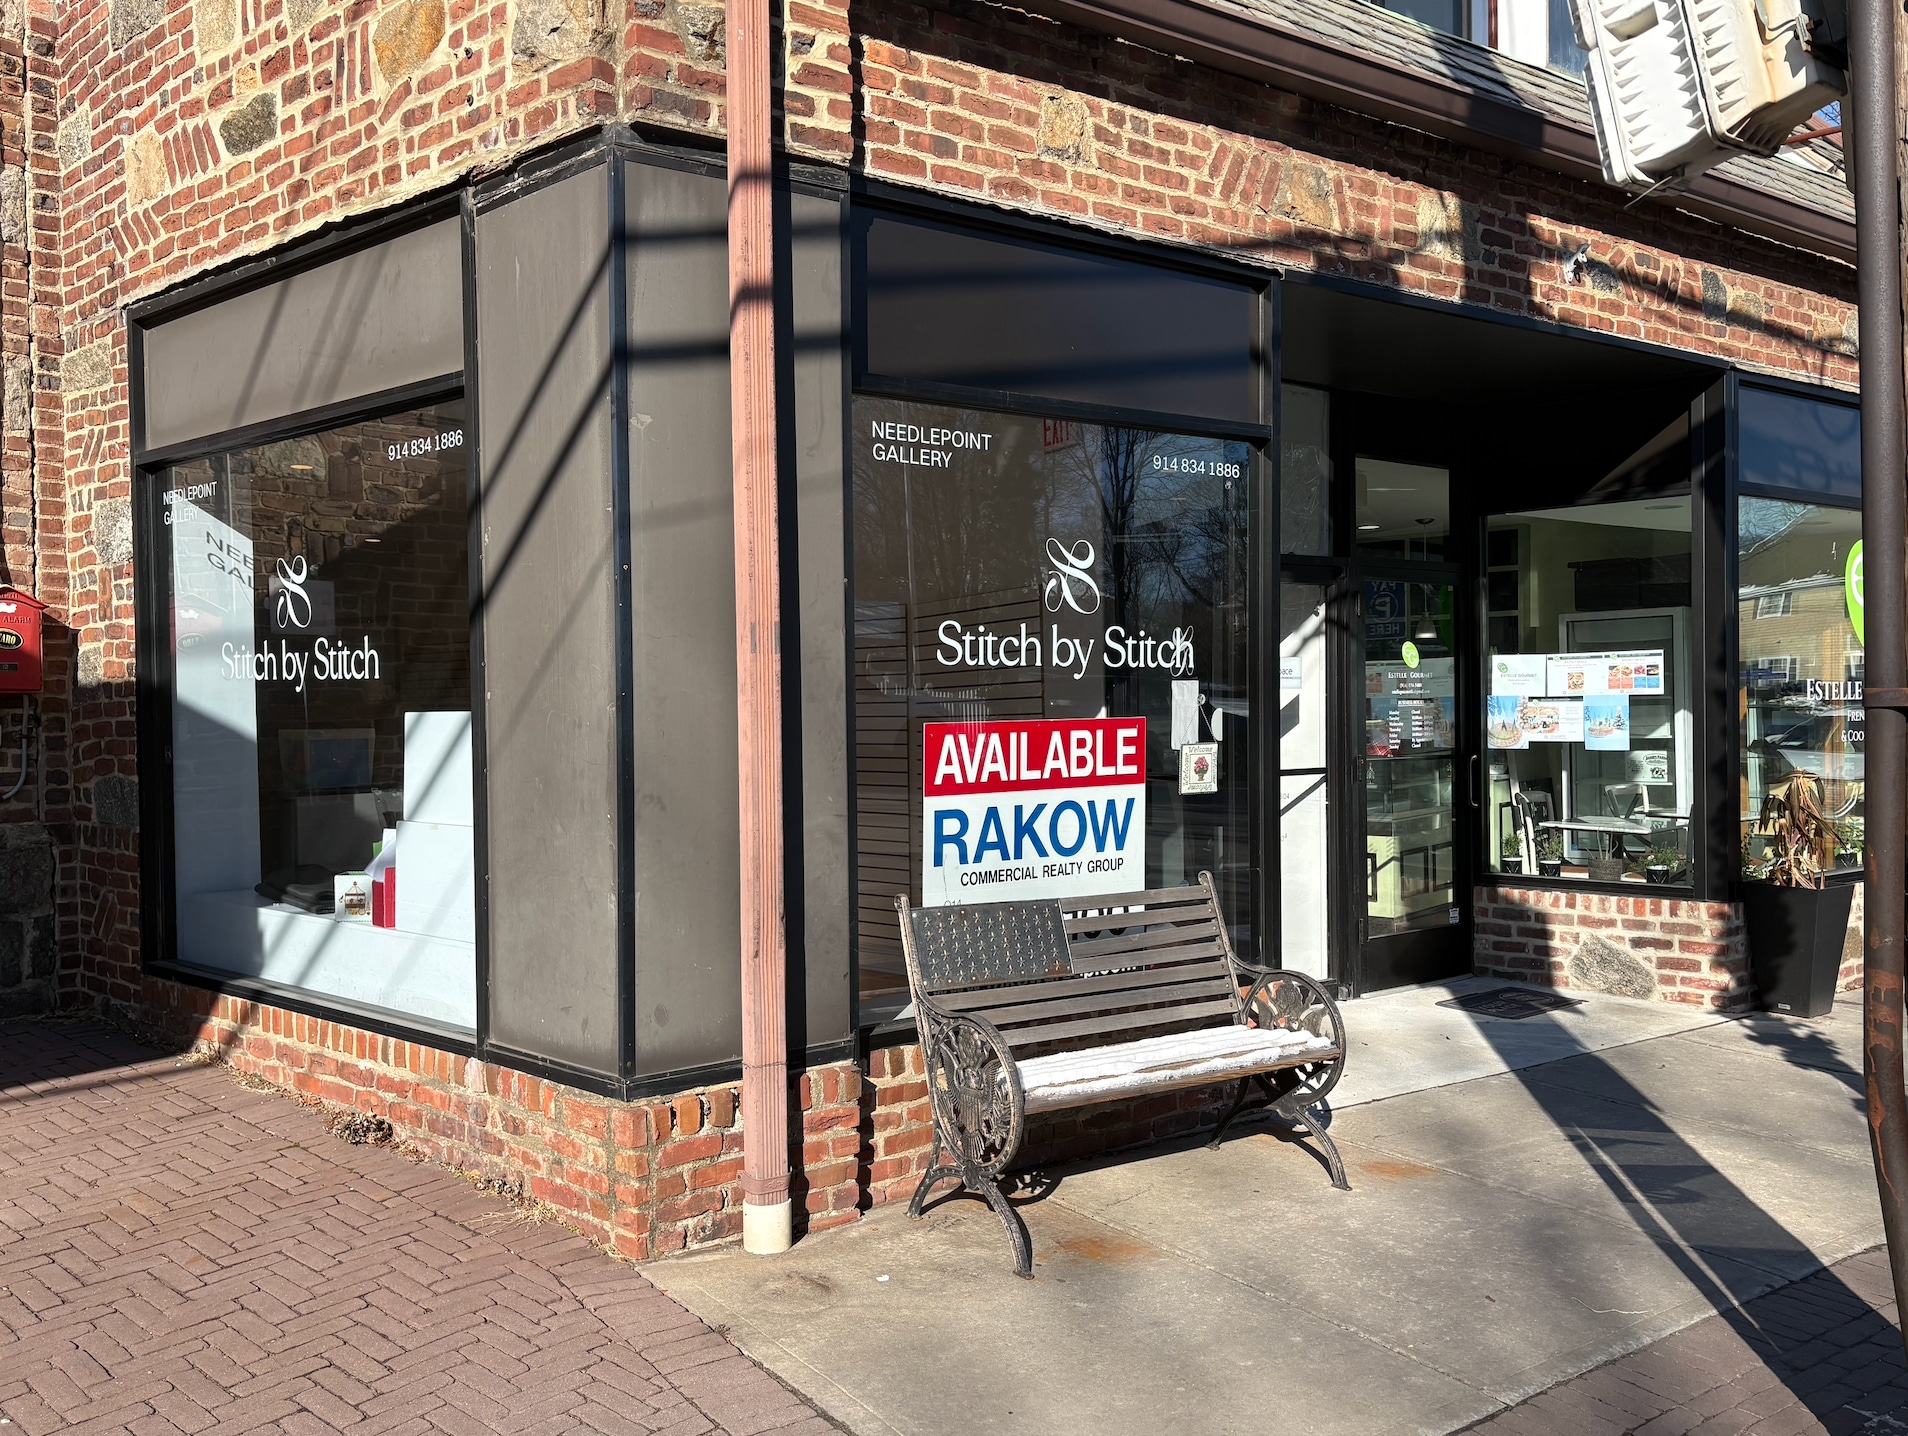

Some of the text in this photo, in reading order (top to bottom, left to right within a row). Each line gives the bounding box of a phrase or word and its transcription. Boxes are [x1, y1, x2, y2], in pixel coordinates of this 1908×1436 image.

[388, 429, 463, 461] 914 834 1886
[872, 421, 992, 450] NEEDLEPOINT
[872, 443, 953, 468] GALLERY
[1153, 455, 1240, 478] 914 834 1886
[163, 481, 217, 505] NEEDLEPOINT
[163, 506, 199, 525] GALLERY
[221, 641, 277, 681] Stitch
[281, 638, 308, 693] by
[313, 634, 380, 681] Stitch
[936, 620, 1195, 680] Stitch by Stitch
[1806, 678, 1863, 701] ESTELLE
[1841, 729, 1847, 742] &
[933, 727, 1139, 786] AVAILABLE
[933, 797, 1136, 868] RAKOW
[960, 857, 1124, 887] COMMERCIAL REALTY GROUP
